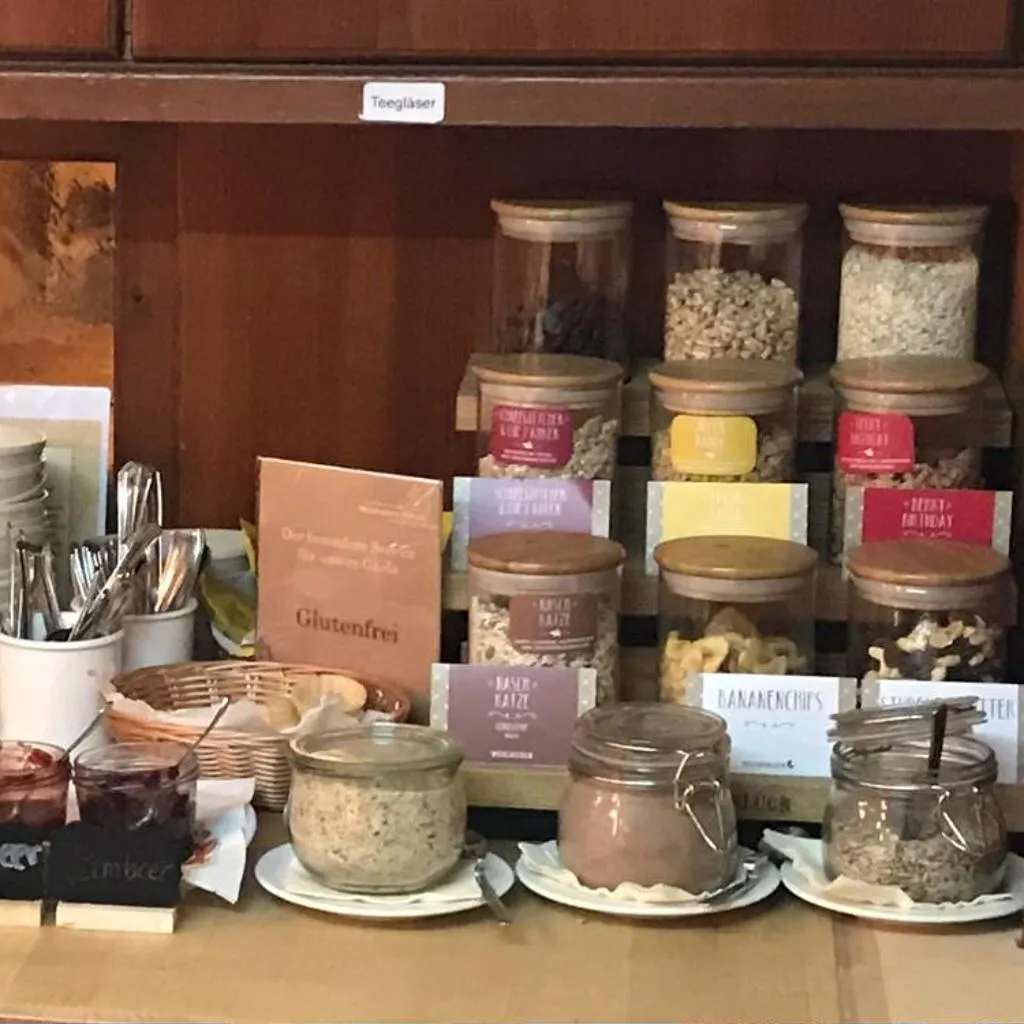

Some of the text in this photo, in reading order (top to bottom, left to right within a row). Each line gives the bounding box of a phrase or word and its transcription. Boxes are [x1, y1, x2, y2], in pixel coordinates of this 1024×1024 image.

[370, 94, 436, 112] Teegläser
[295, 606, 400, 644] Glutenfrei
[717, 688, 824, 712] BANANENCHIPS
